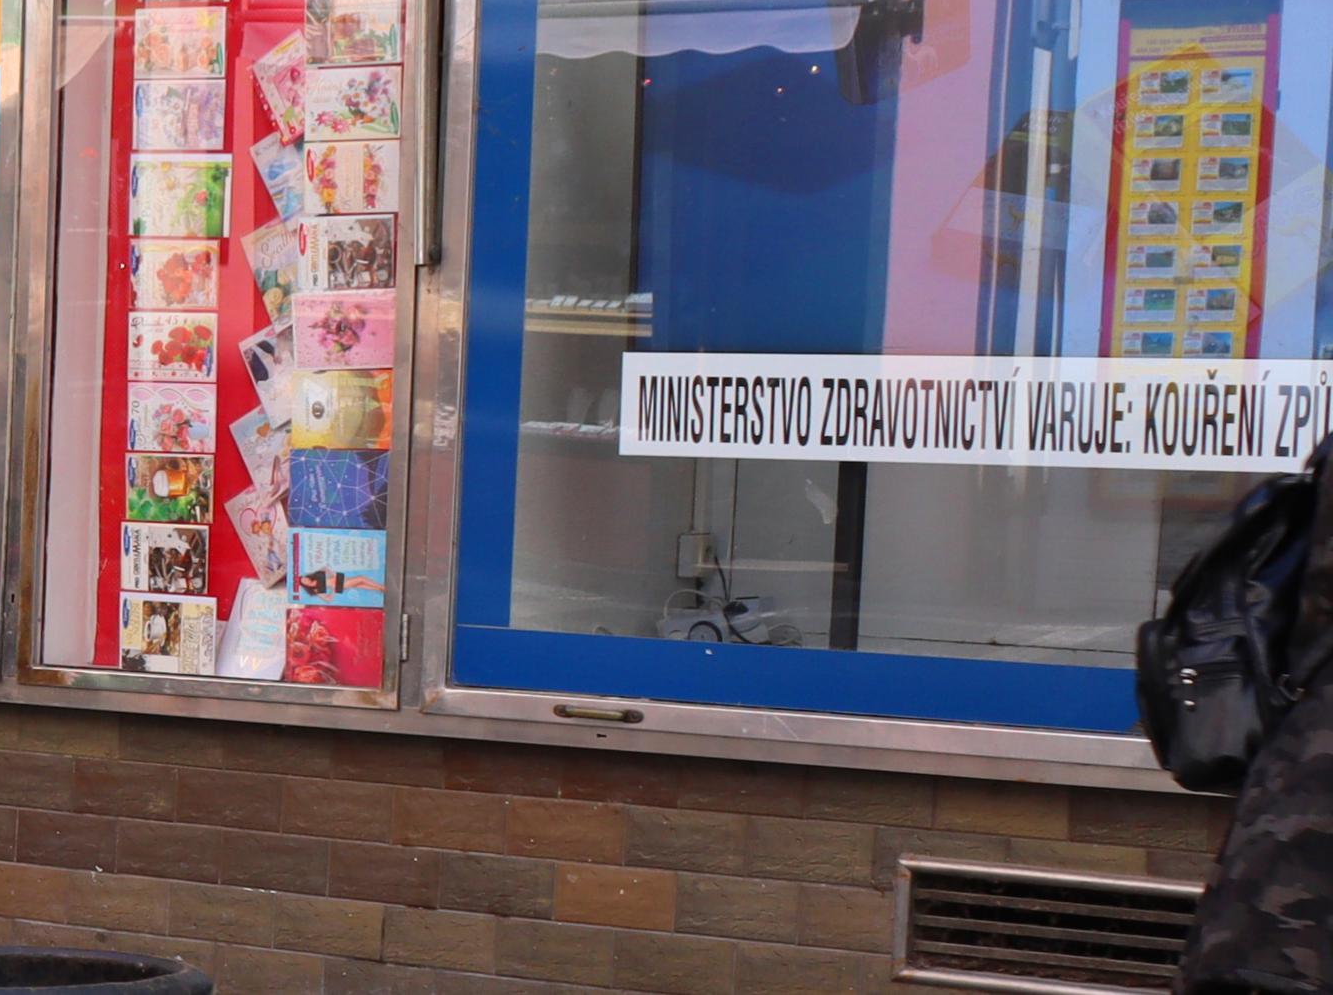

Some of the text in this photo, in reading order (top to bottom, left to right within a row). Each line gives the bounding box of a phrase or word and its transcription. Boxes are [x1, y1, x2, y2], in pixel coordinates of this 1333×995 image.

[637, 373, 813, 446] MINISTERSTVO
[820, 366, 1020, 453] ZDRAVOTNICTVÍ
[1026, 379, 1133, 455] VARUJE:
[1142, 367, 1270, 457] KOUŘENÍ
